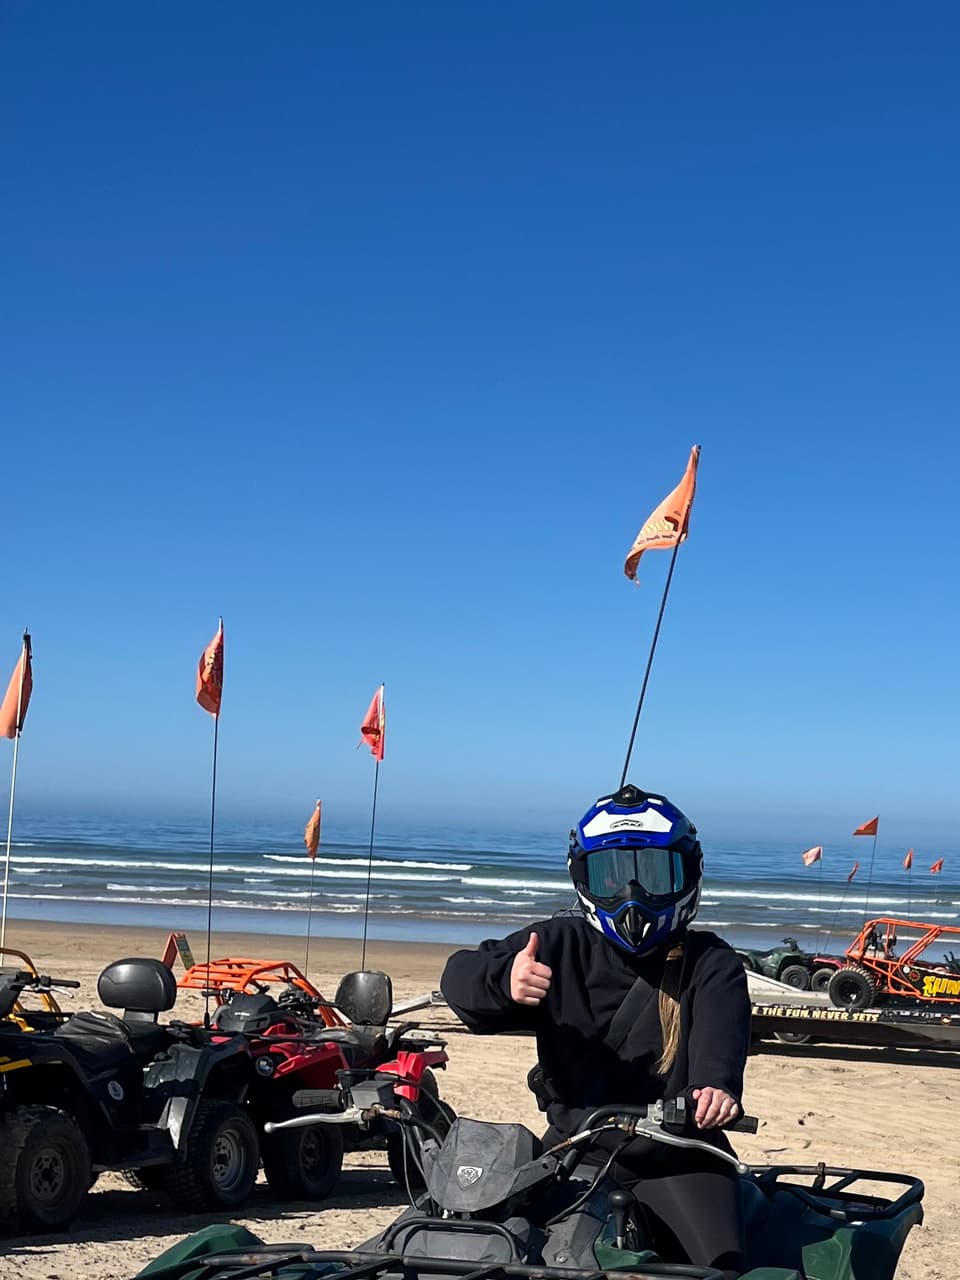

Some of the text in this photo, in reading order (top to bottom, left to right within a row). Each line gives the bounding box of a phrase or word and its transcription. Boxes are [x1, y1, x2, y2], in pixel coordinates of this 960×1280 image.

[763, 1007, 783, 1017] THE
[812, 1010, 849, 1020] NEVER
[852, 1012, 880, 1022] SETS
